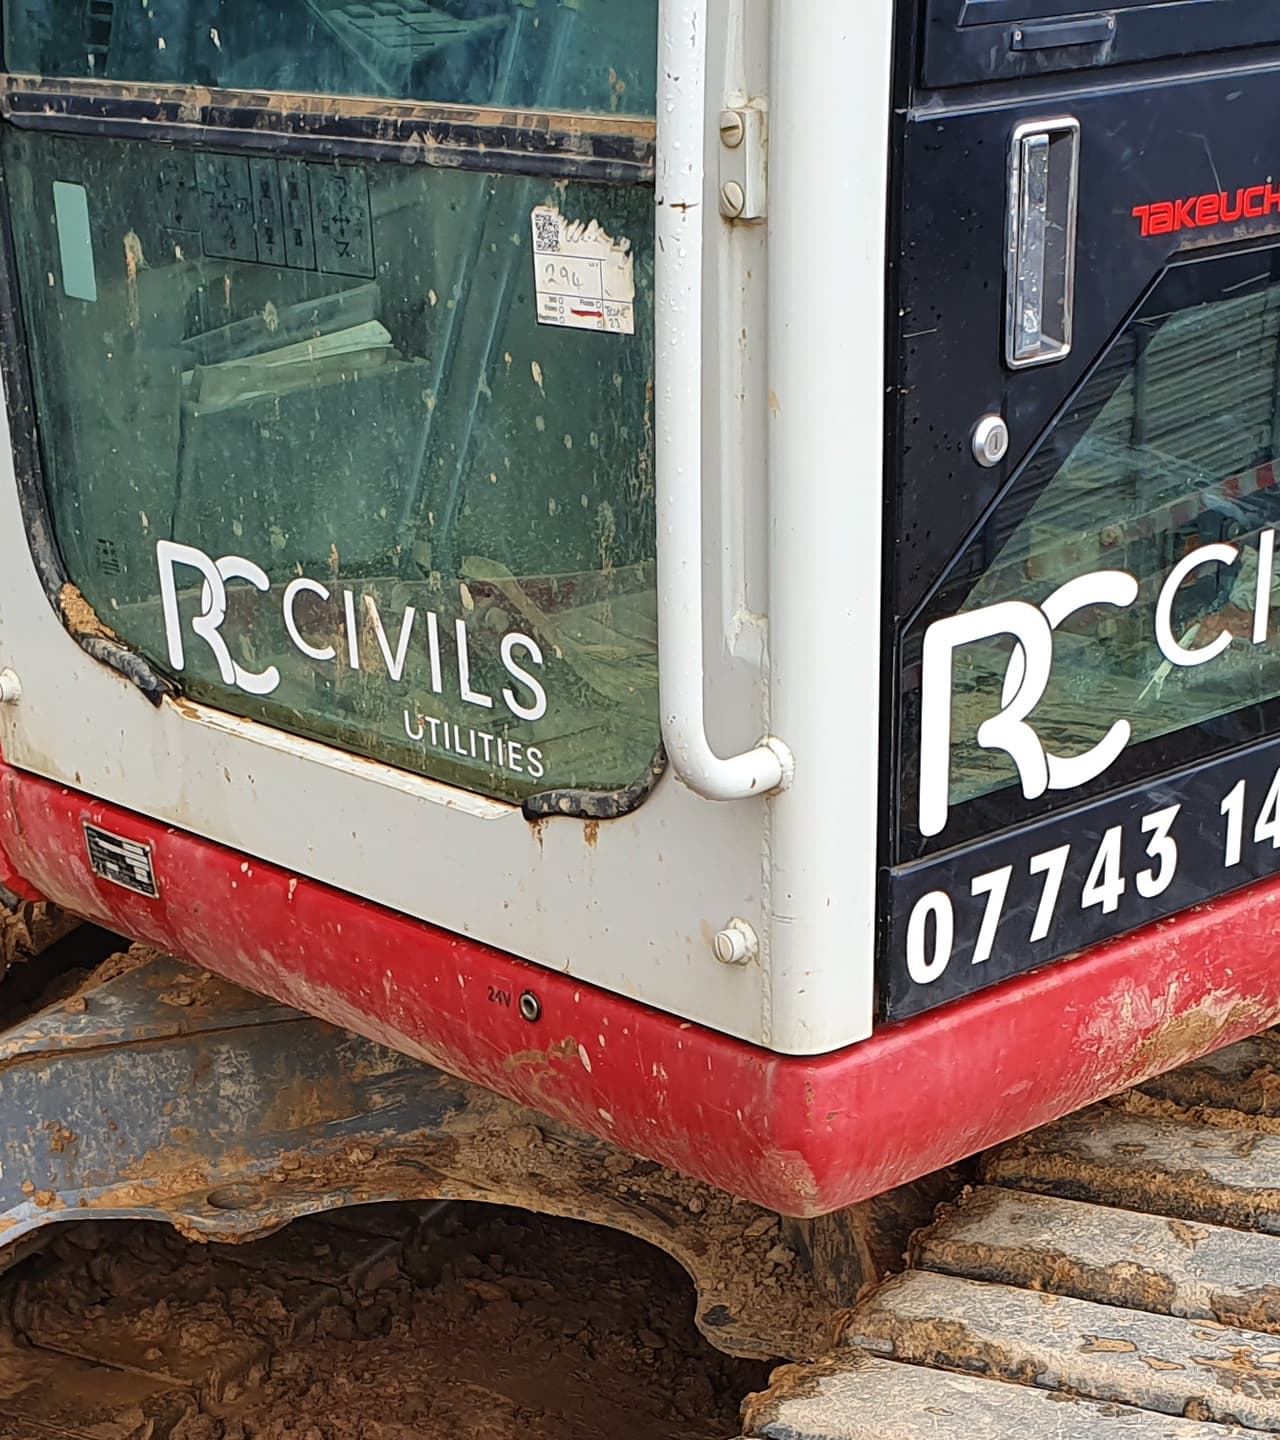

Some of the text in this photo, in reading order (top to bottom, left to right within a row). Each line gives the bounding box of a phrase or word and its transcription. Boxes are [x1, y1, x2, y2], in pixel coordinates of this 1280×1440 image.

[154, 539, 549, 723] RC CIVILS
[917, 569, 1139, 838] RC
[404, 709, 546, 778] UTILITIES
[905, 804, 1182, 985] 07743
[486, 985, 512, 1008] 24V
